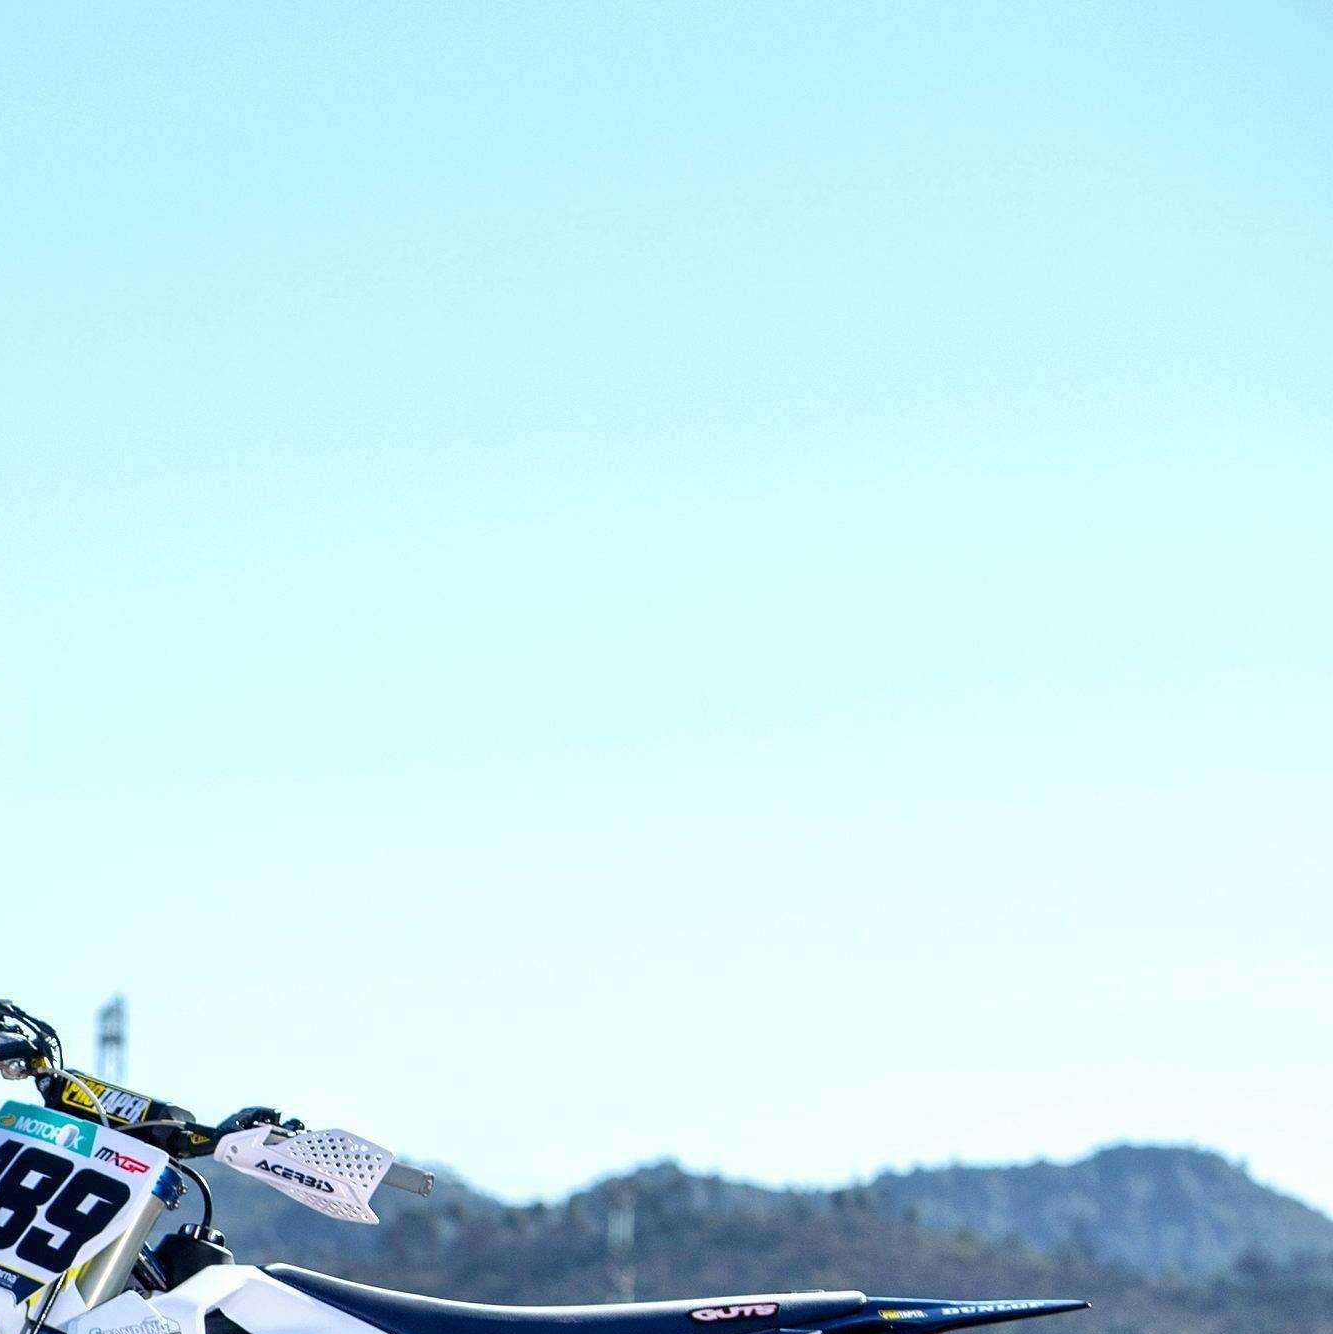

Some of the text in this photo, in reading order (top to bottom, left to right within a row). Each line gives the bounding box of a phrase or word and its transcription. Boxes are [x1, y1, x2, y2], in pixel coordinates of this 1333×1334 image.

[95, 1146, 150, 1174] MXGP
[255, 1159, 335, 1194] ACERBIS
[690, 1304, 779, 1321] GUTS
